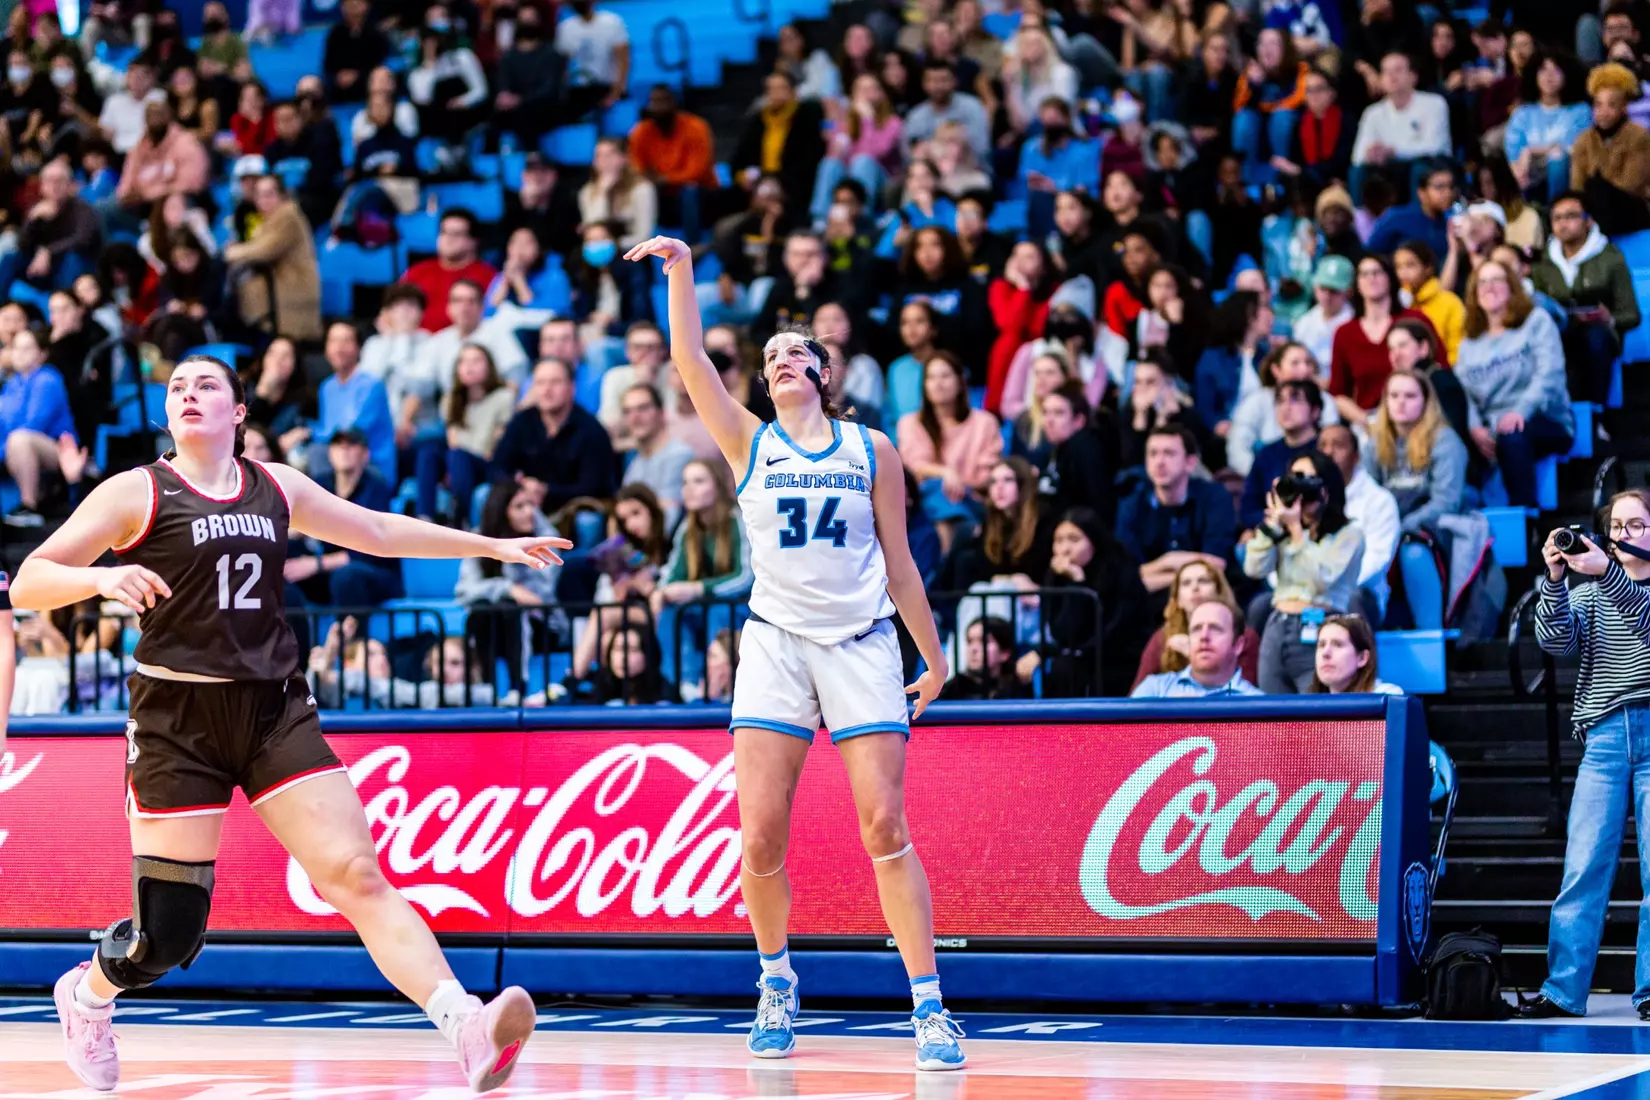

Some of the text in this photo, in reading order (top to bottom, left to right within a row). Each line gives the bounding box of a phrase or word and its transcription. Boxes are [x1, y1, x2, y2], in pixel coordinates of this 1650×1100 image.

[765, 473, 865, 492] COLUMBIA
[191, 514, 276, 547] BROWN
[777, 496, 848, 549] 34
[216, 553, 262, 610] 12
[1079, 736, 1382, 923] Coca-
[886, 938, 967, 947] DNICS
